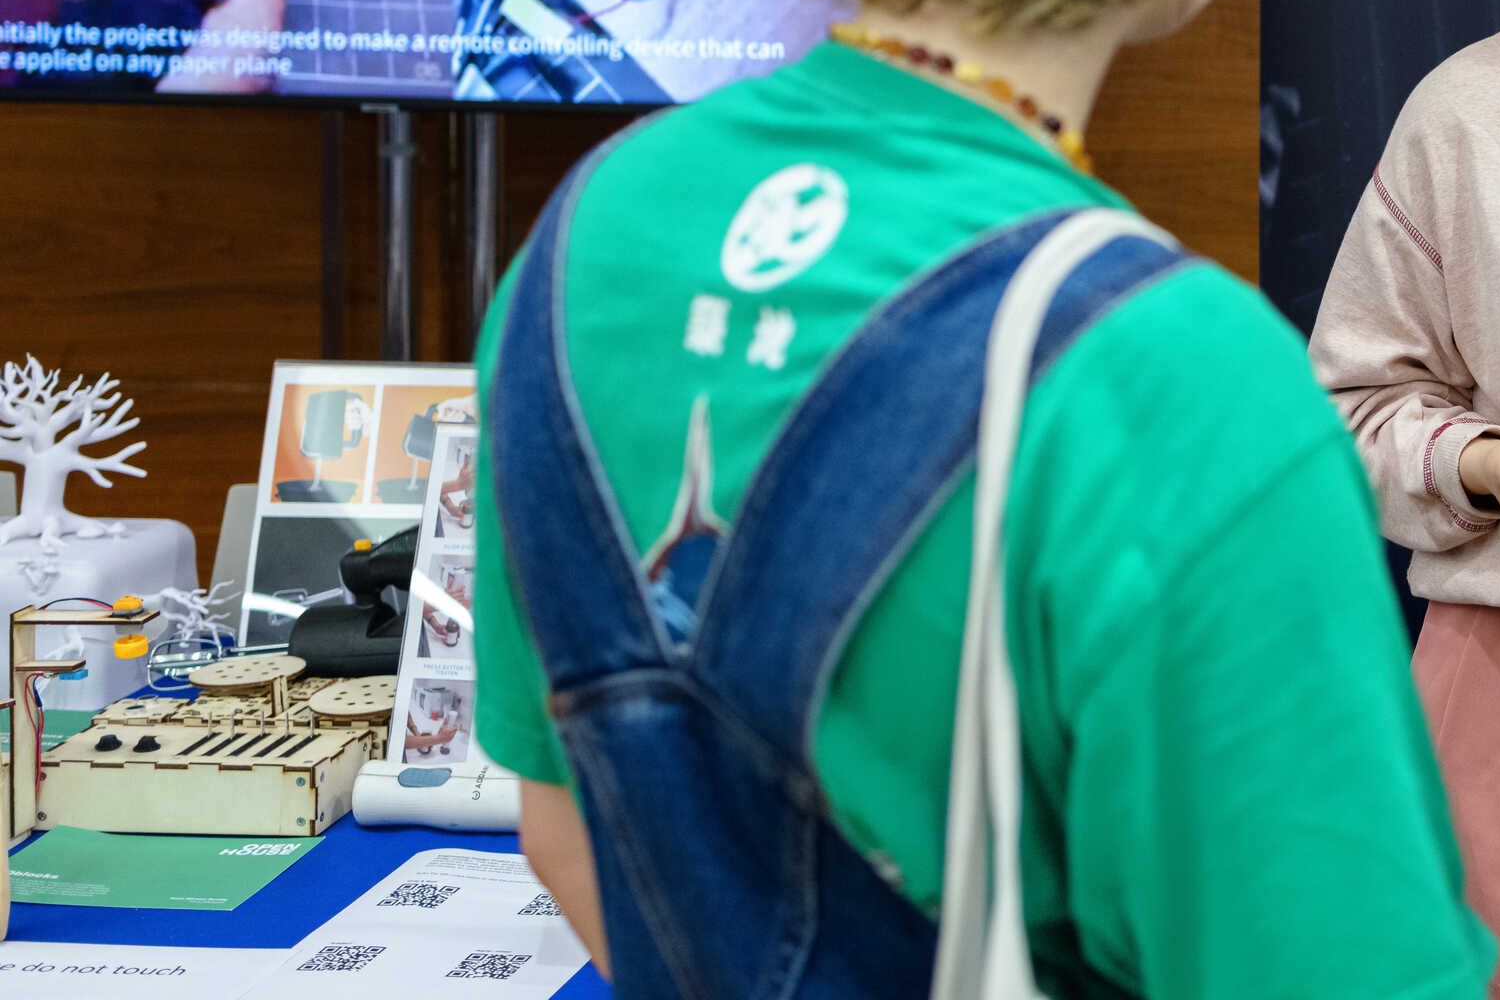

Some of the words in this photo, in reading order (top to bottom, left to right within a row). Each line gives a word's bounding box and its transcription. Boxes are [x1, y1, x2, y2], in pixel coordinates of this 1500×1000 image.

[65, 22, 100, 45] the
[103, 23, 177, 50] project
[181, 29, 223, 46] was
[228, 27, 318, 54] designed
[323, 30, 345, 49] to
[351, 30, 406, 52] make
[411, 38, 426, 52] a
[429, 33, 503, 54] remote
[508, 33, 623, 61] controlling
[626, 35, 697, 58] device
[700, 37, 743, 59] that
[747, 42, 784, 60] can
[14, 49, 92, 74] applied
[95, 53, 123, 72] on
[126, 53, 165, 78] any
[168, 54, 227, 76] paper
[233, 52, 292, 76] plane
[242, 843, 301, 851] OPEN
[22, 962, 56, 973] do
[61, 965, 108, 975] not
[113, 965, 187, 976] touch
